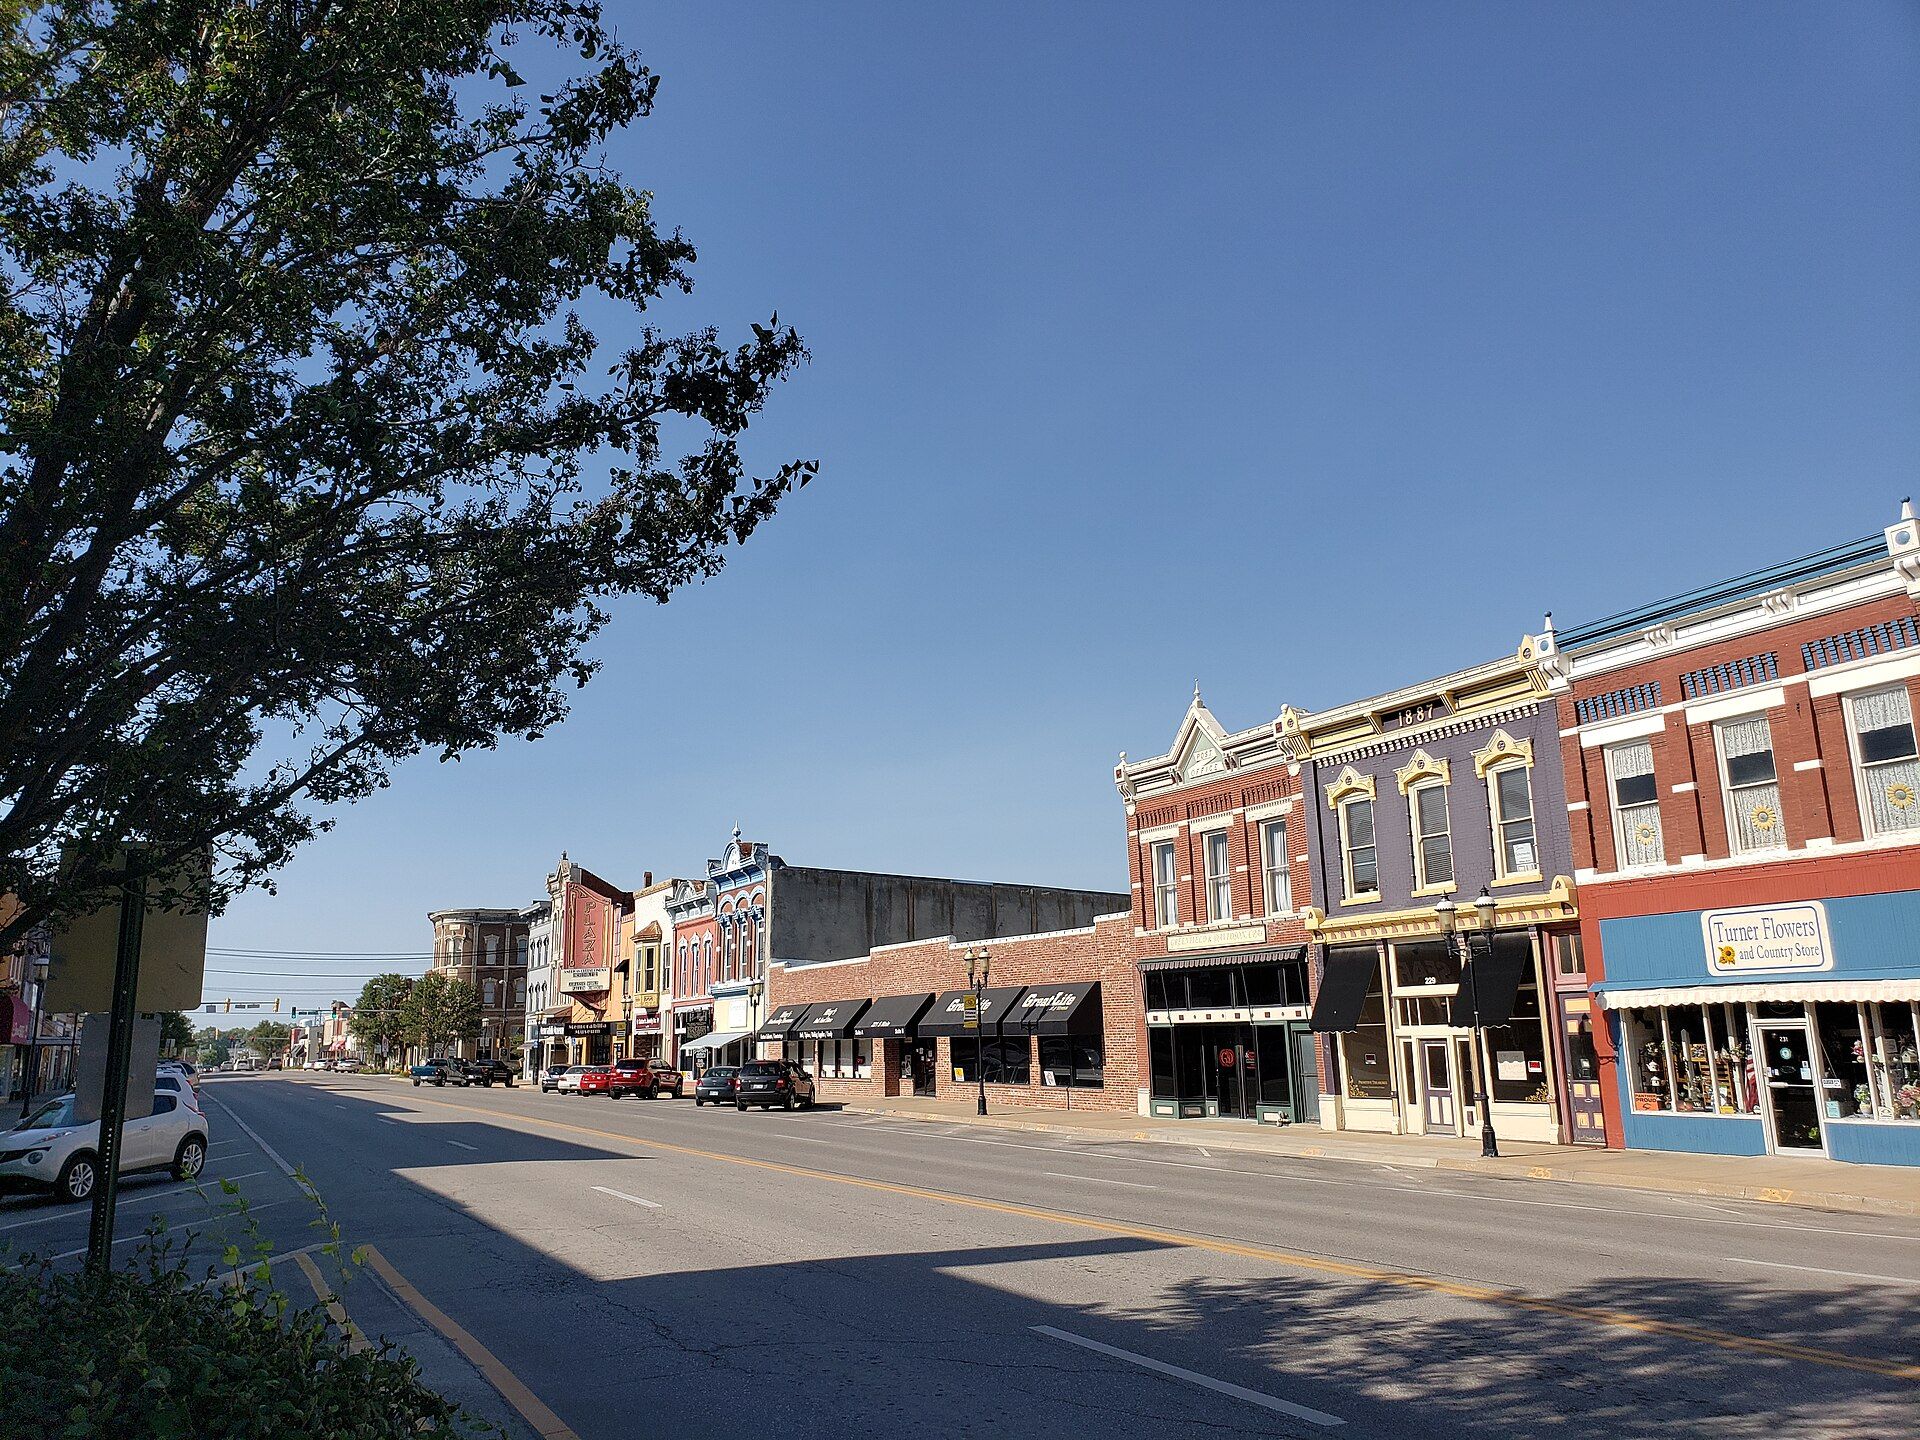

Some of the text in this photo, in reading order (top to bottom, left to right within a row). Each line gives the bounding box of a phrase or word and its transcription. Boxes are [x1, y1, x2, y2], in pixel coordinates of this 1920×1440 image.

[1398, 703, 1433, 727] 1887
[1196, 749, 1213, 760] POST
[1190, 763, 1218, 777] OFFICE
[581, 901, 597, 966] PLAZA
[1713, 917, 1816, 943] Turner Flowers
[1738, 942, 1820, 962] and Country Store
[1424, 976, 1437, 985] 229
